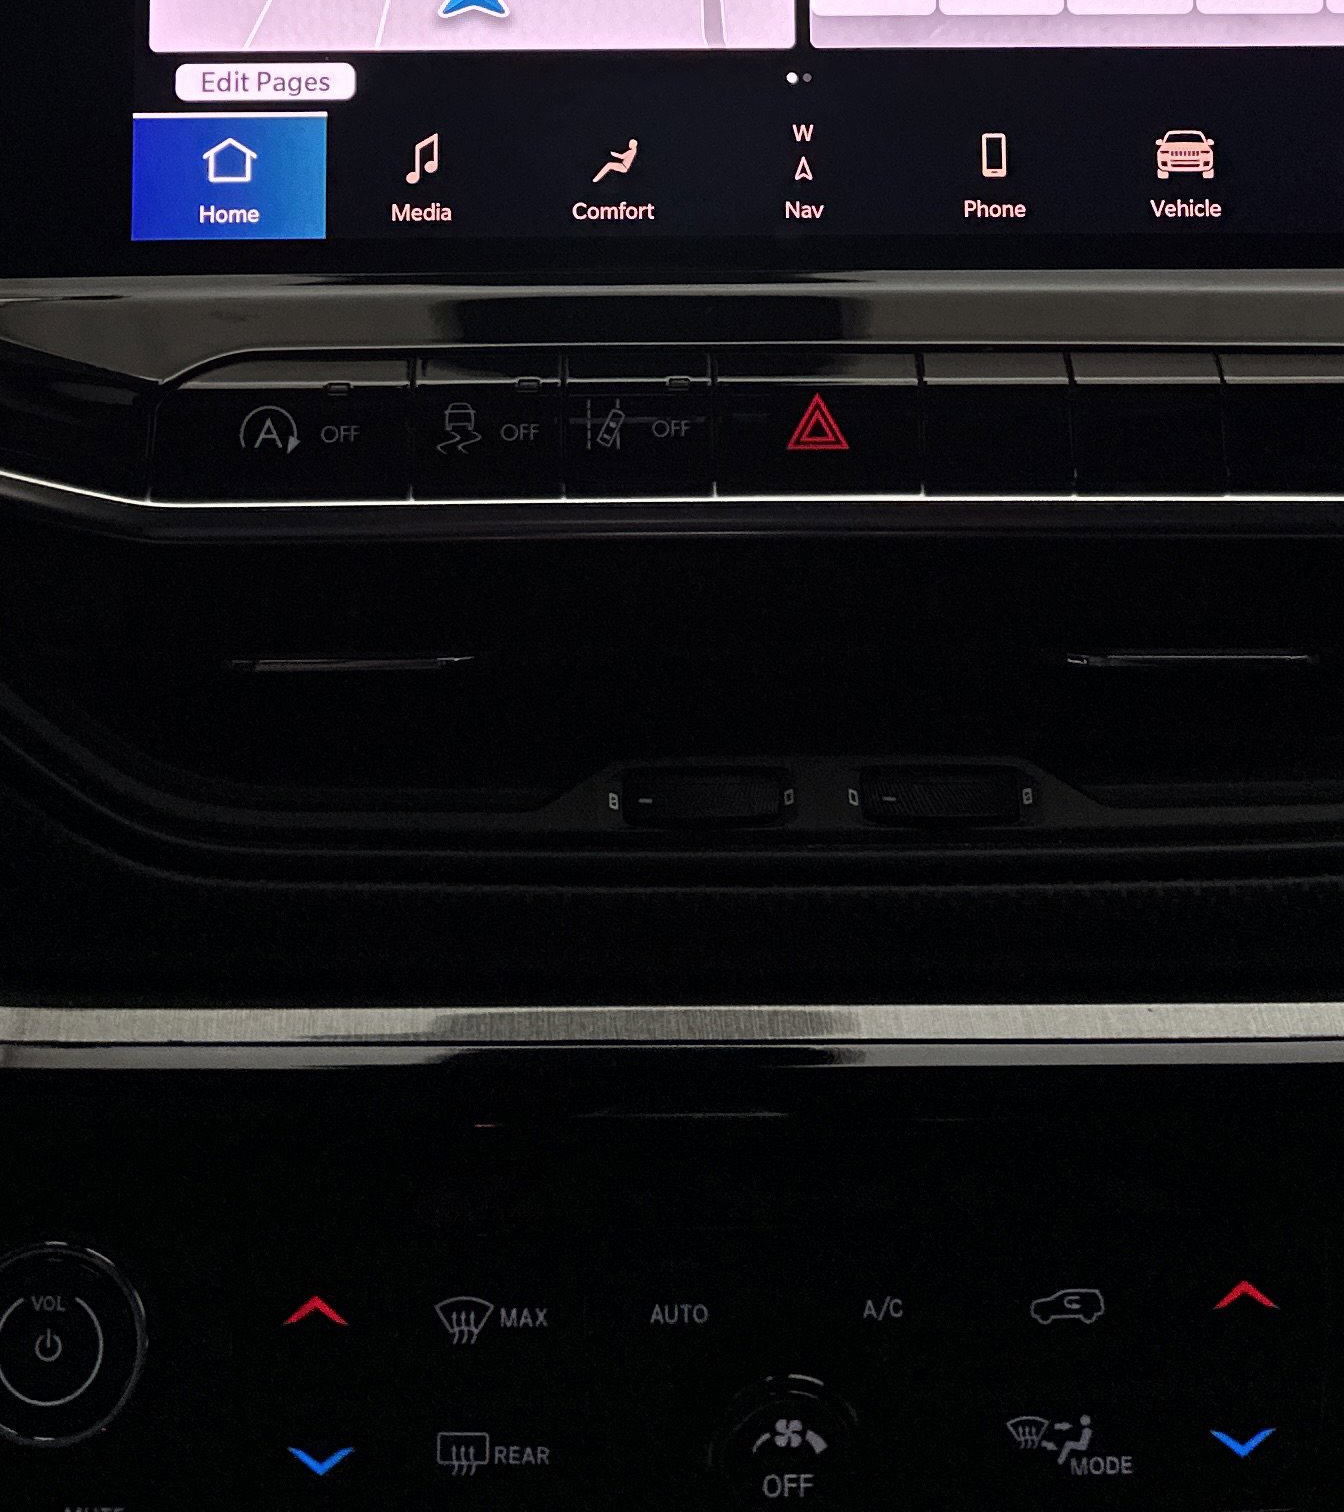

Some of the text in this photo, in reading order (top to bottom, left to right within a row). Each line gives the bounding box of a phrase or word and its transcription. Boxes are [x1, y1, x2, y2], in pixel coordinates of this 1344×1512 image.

[201, 70, 331, 97] Edit Pages
[792, 123, 814, 142] W
[198, 204, 260, 224] Home
[391, 202, 452, 222] Media
[571, 201, 655, 220] Comfort
[785, 200, 825, 219] Nav
[963, 199, 1027, 218] Phone
[1149, 198, 1222, 218] Vehicle
[320, 424, 359, 444] OFF
[499, 423, 539, 442] OFF
[649, 416, 690, 438] OFF
[30, 1295, 66, 1312] VOL
[863, 1295, 904, 1321] A/C
[500, 1307, 548, 1328] MAX
[649, 1303, 709, 1325] AUTO
[494, 1445, 550, 1465] REAR
[1070, 1455, 1133, 1476] MODE
[762, 1473, 814, 1498] OFF
